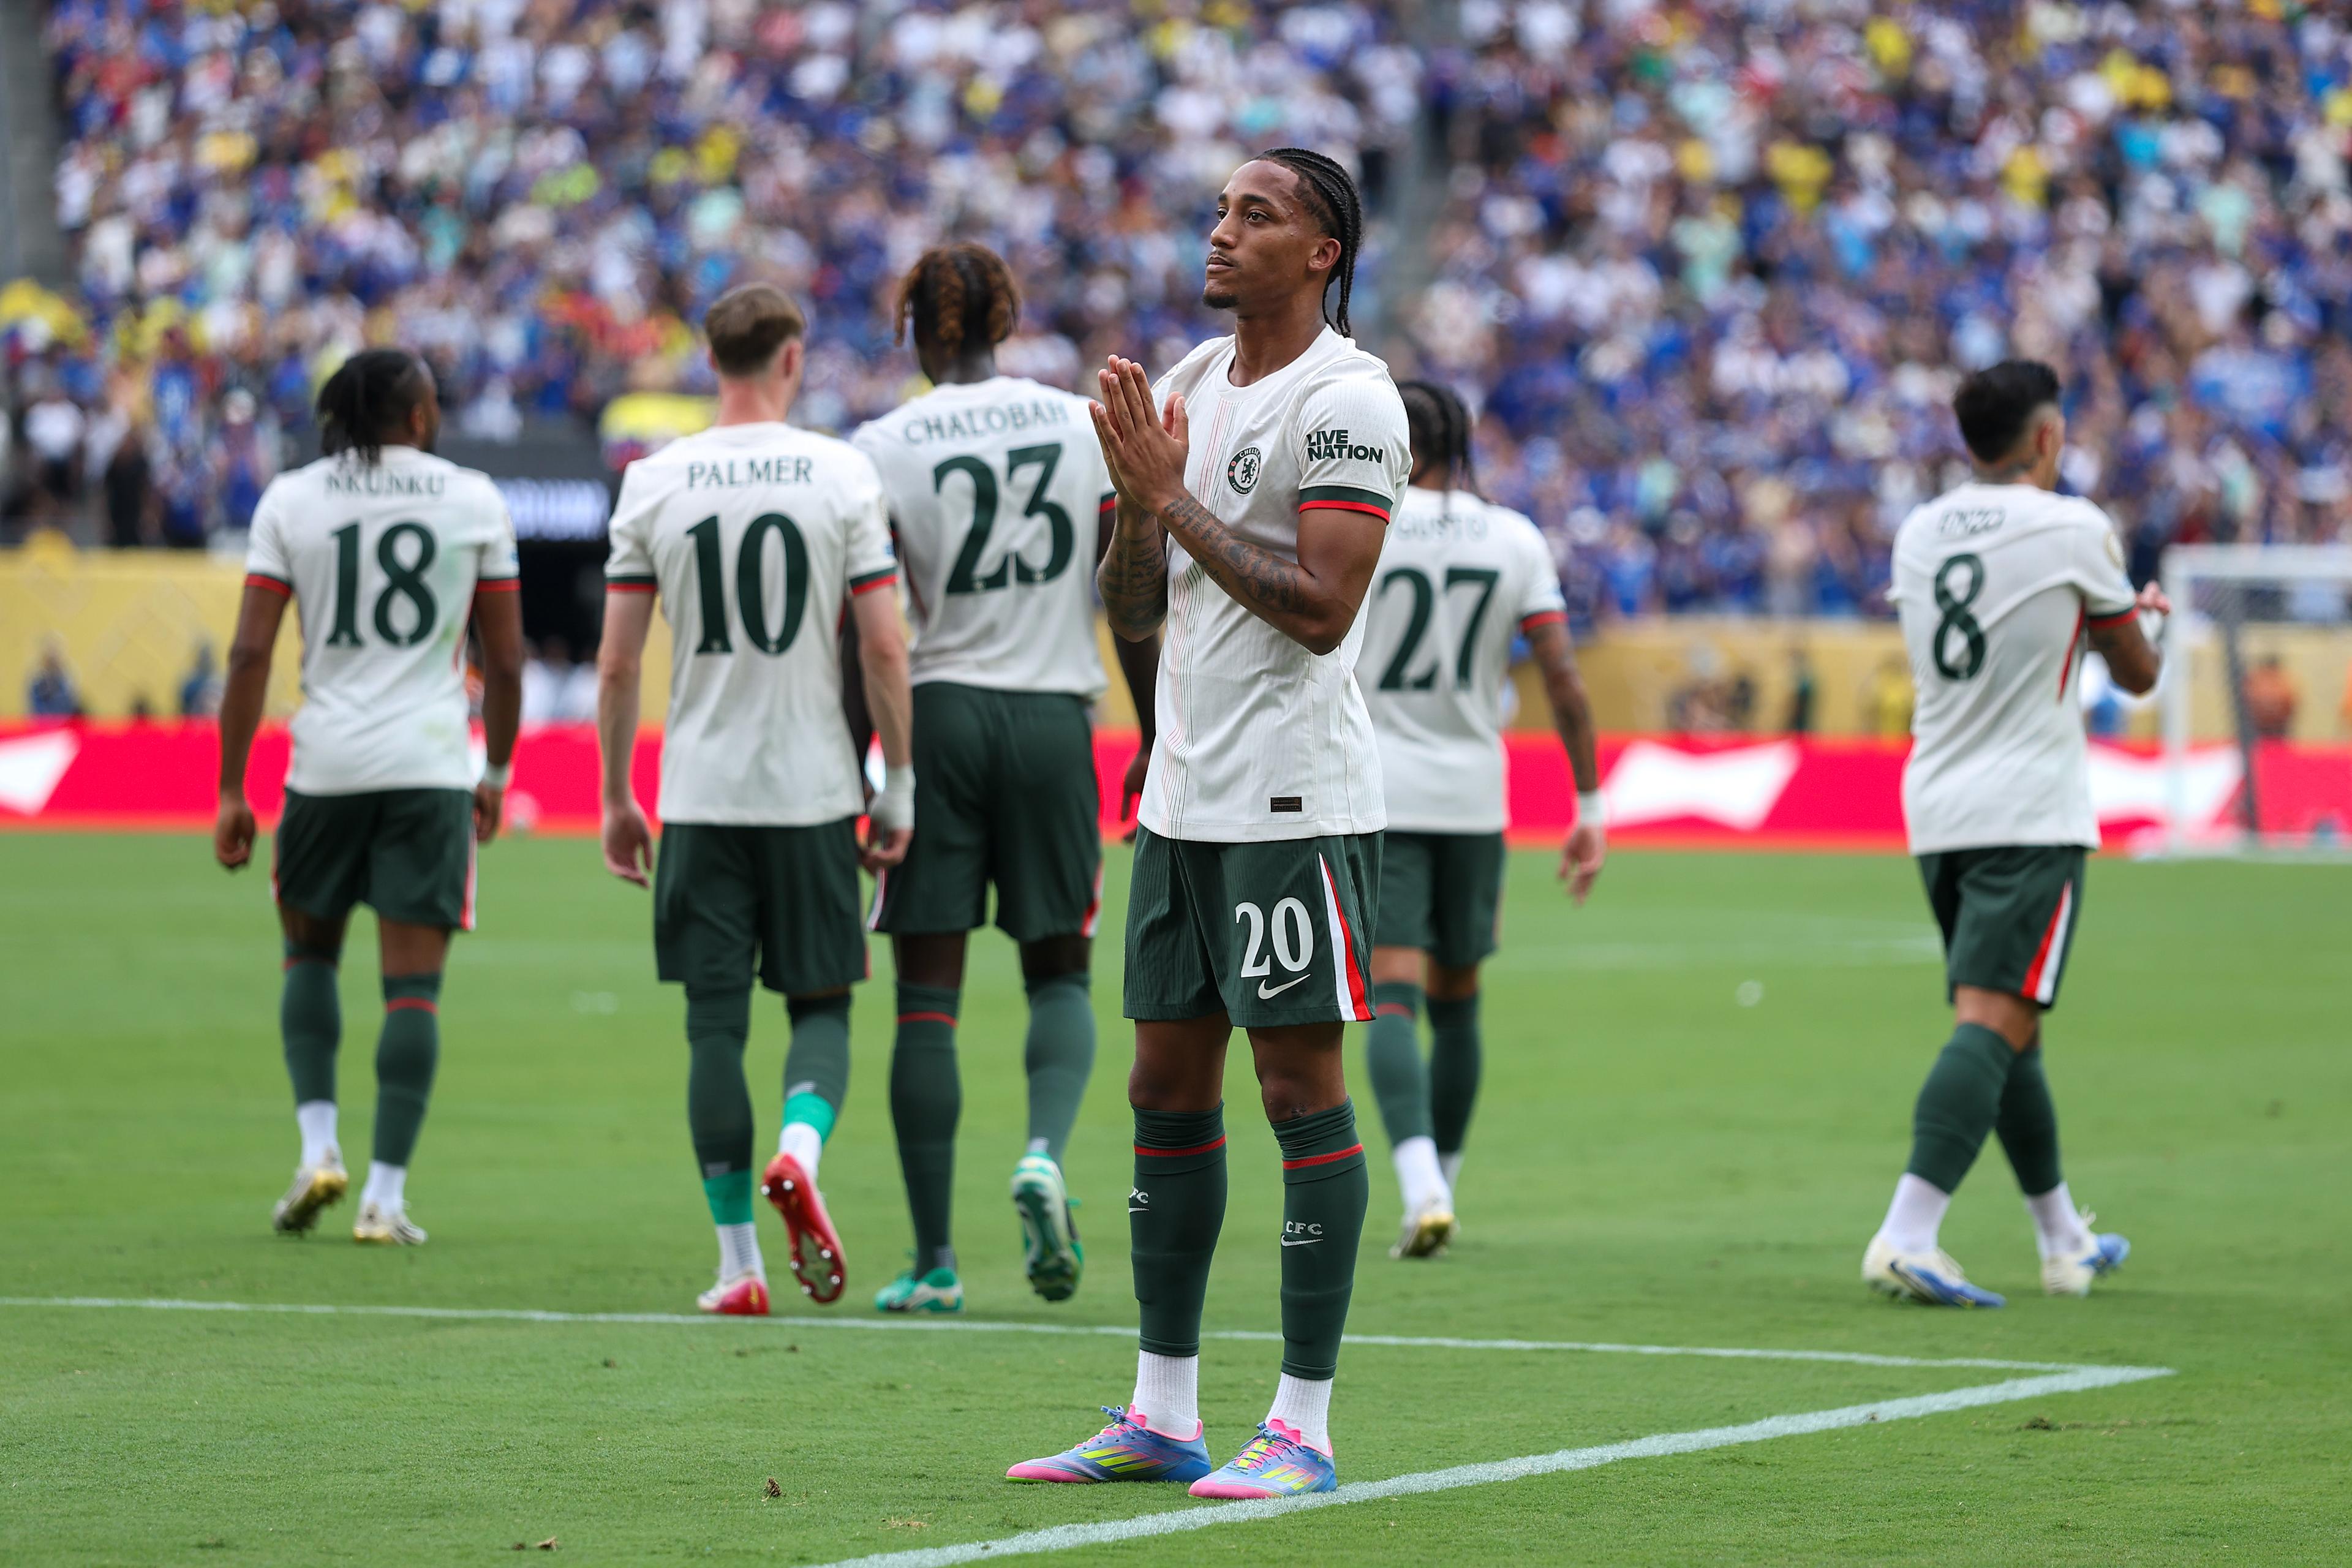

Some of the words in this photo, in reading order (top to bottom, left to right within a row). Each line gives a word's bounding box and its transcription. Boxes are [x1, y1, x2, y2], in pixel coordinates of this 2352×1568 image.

[904, 399, 1070, 445] CHALOBAH
[1306, 430, 1348, 447] LIVE
[687, 454, 813, 489] PALMER
[1308, 445, 1383, 463] NATION
[933, 443, 1074, 595] 23
[325, 521, 439, 649] 18
[685, 513, 809, 655] 10
[1377, 566, 1502, 692] 27
[1932, 553, 1986, 681] 8
[1235, 897, 1314, 978] 20
[1129, 1186, 1149, 1204] FC
[1286, 1220, 1323, 1235] CFC
